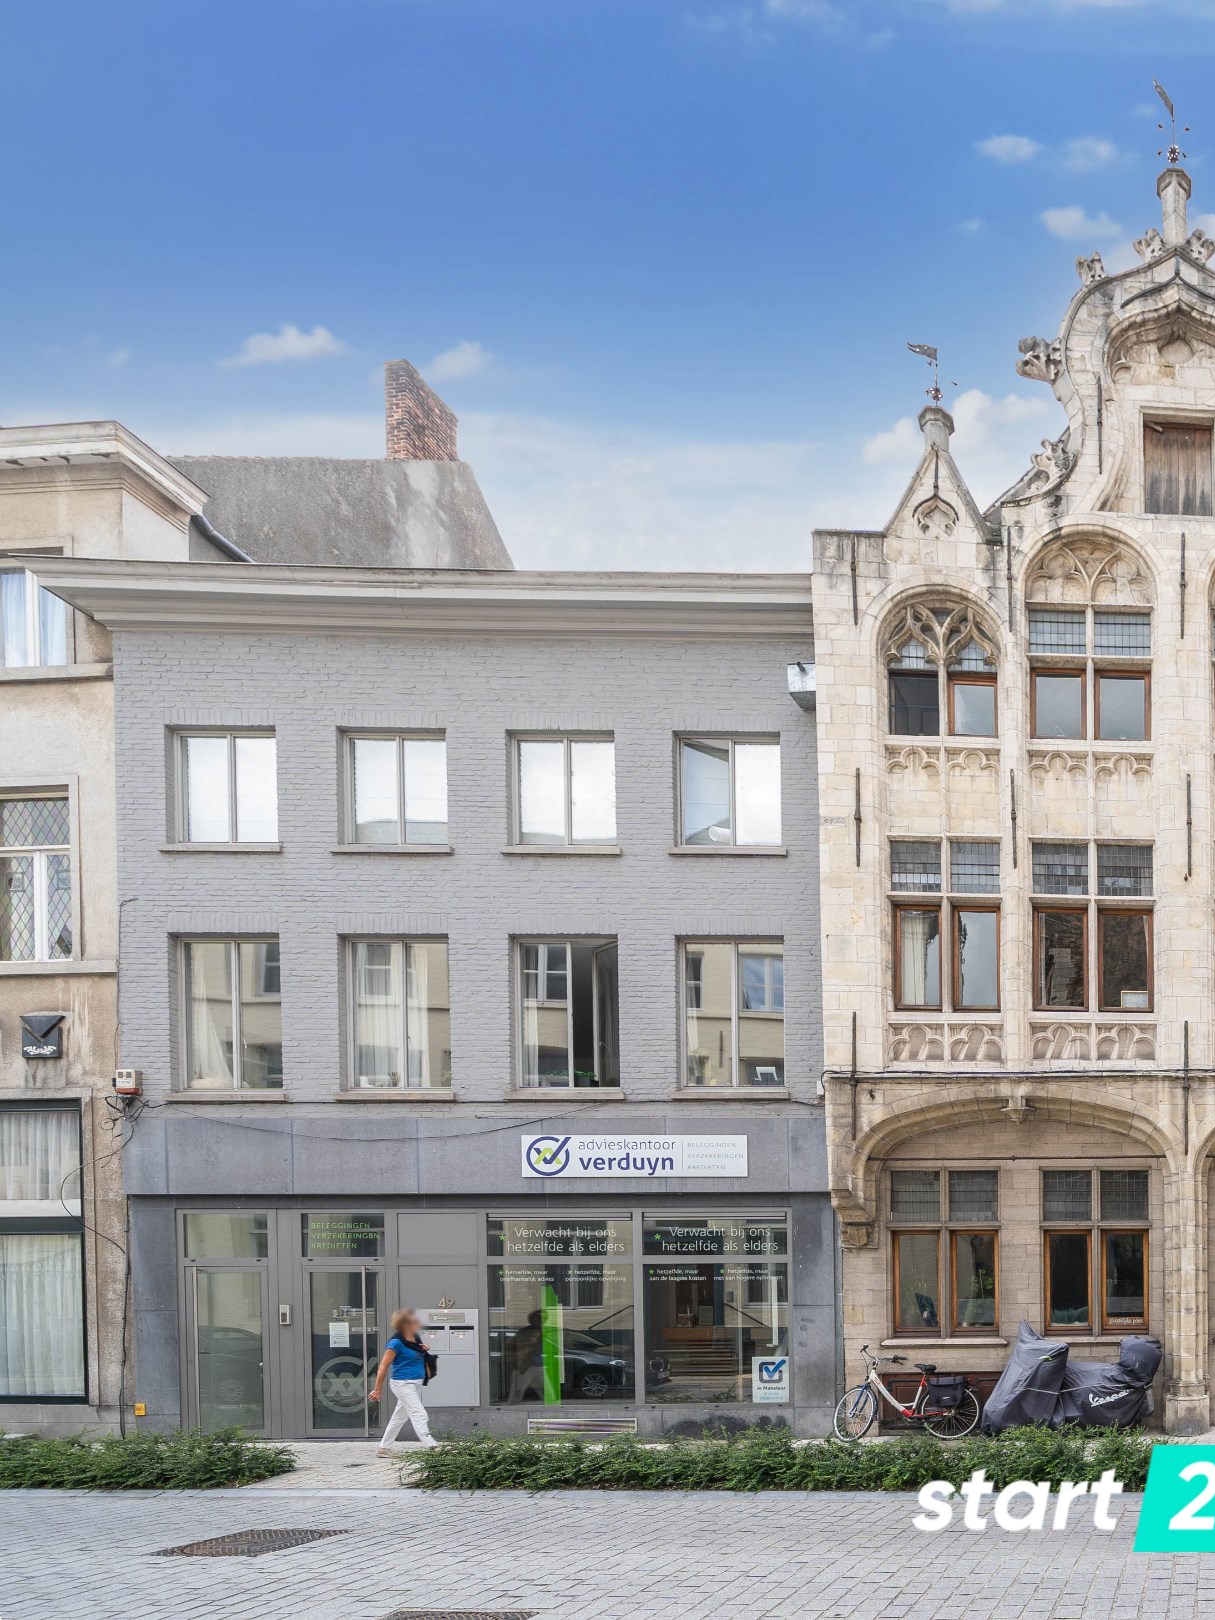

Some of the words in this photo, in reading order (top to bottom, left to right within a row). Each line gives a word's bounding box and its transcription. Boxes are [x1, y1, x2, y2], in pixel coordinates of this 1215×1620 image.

[578, 1139, 676, 1150] advieskantoor
[578, 1152, 674, 1176] verduyn
[514, 1227, 571, 1238] Verwacht
[576, 1226, 591, 1240] bij
[595, 1228, 617, 1238] ons
[669, 1226, 726, 1237] Verwacht
[730, 1225, 745, 1239] bij
[749, 1227, 771, 1237] ons
[507, 1240, 564, 1252] hetzelfde
[568, 1240, 585, 1252] als
[588, 1240, 625, 1252] elders
[662, 1240, 718, 1251] hetzelfde
[722, 1240, 739, 1251] als
[743, 1240, 779, 1251] elders
[438, 1297, 455, 1309] 49
[1088, 1390, 1130, 1407] Vespa
